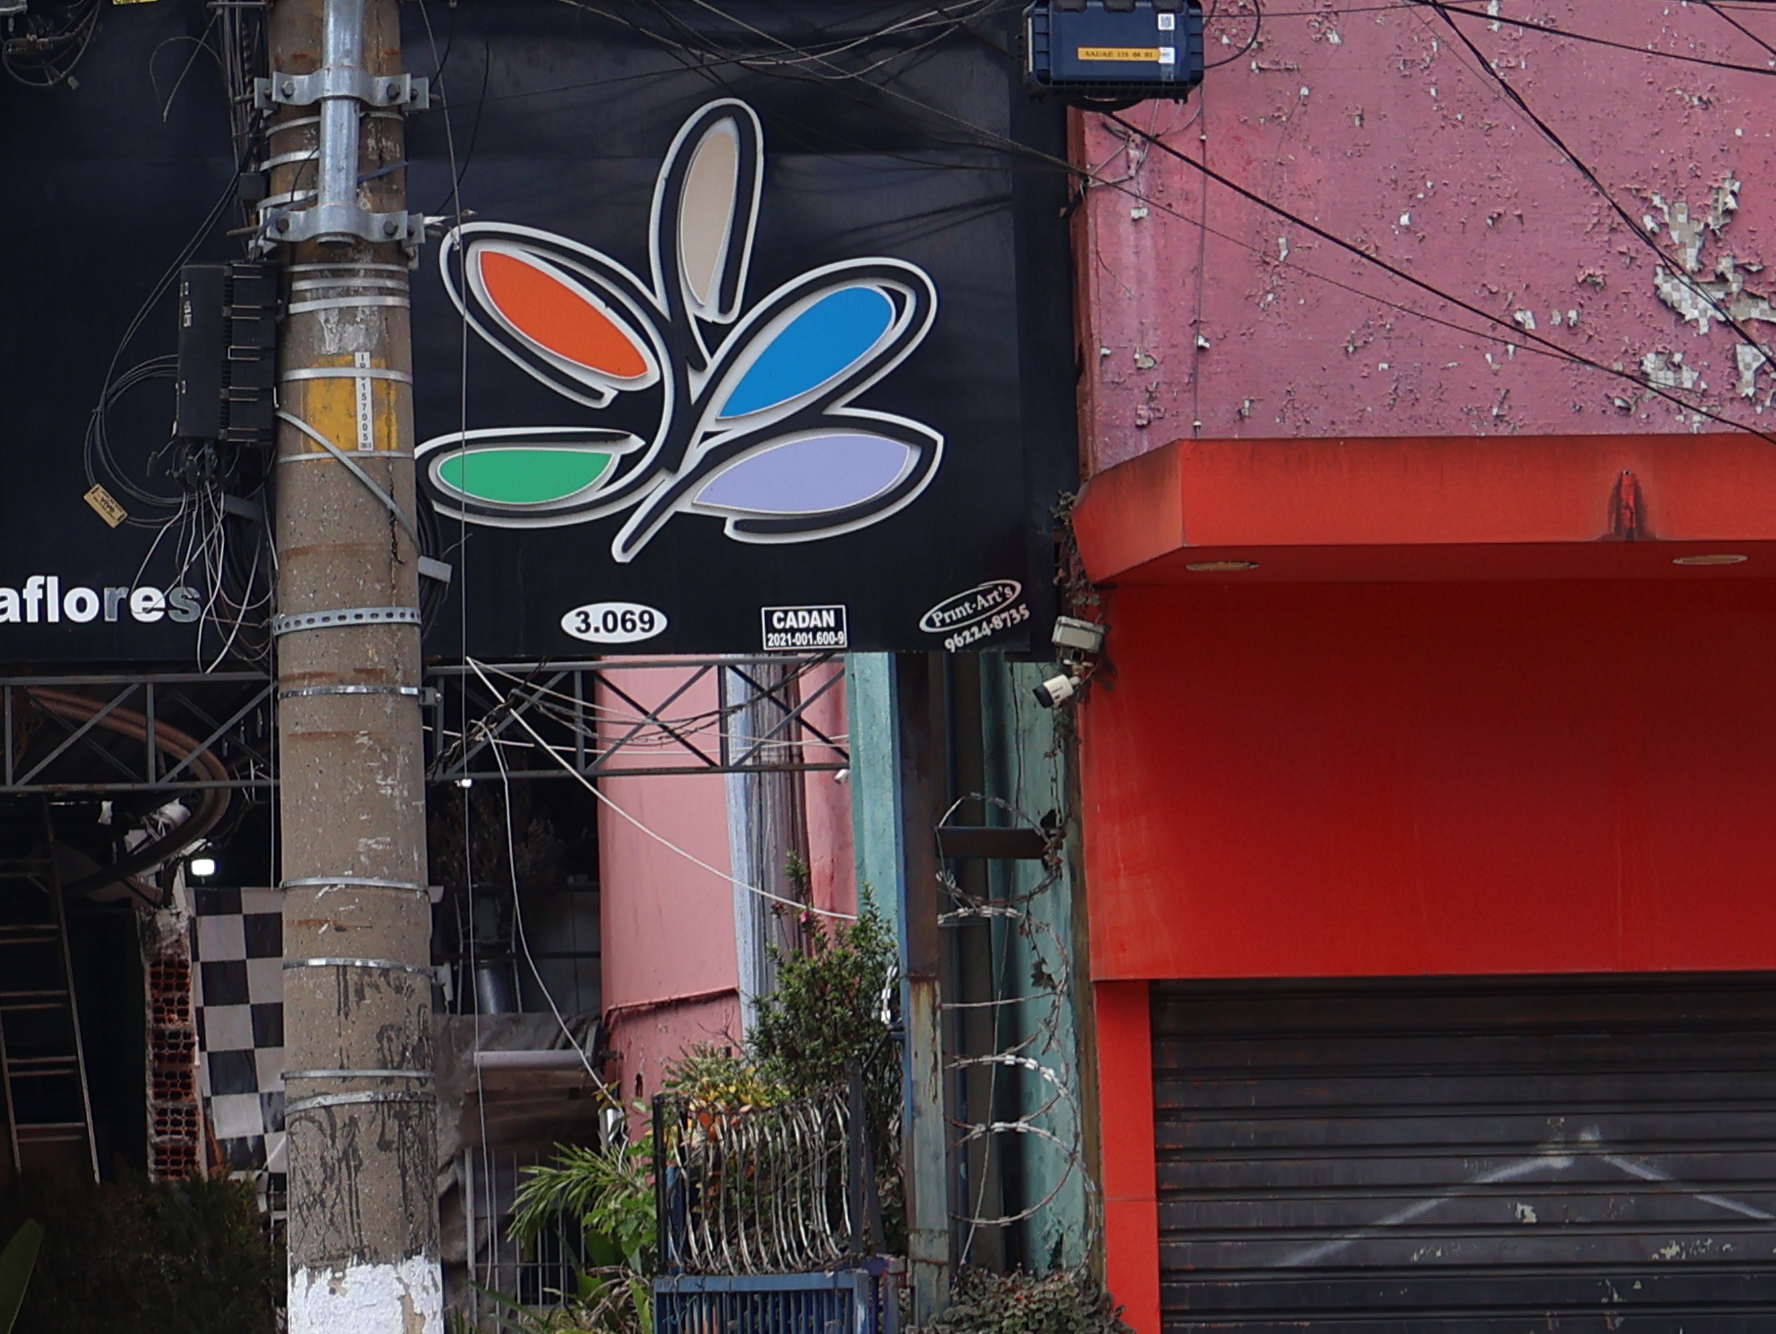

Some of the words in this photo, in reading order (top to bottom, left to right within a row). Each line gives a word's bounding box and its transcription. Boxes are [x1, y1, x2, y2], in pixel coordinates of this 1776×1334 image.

[574, 608, 657, 635] 3.069
[772, 610, 836, 629] CADAN
[944, 602, 1031, 653] 96224-8735
[767, 631, 845, 648] 2021-001.600-9
